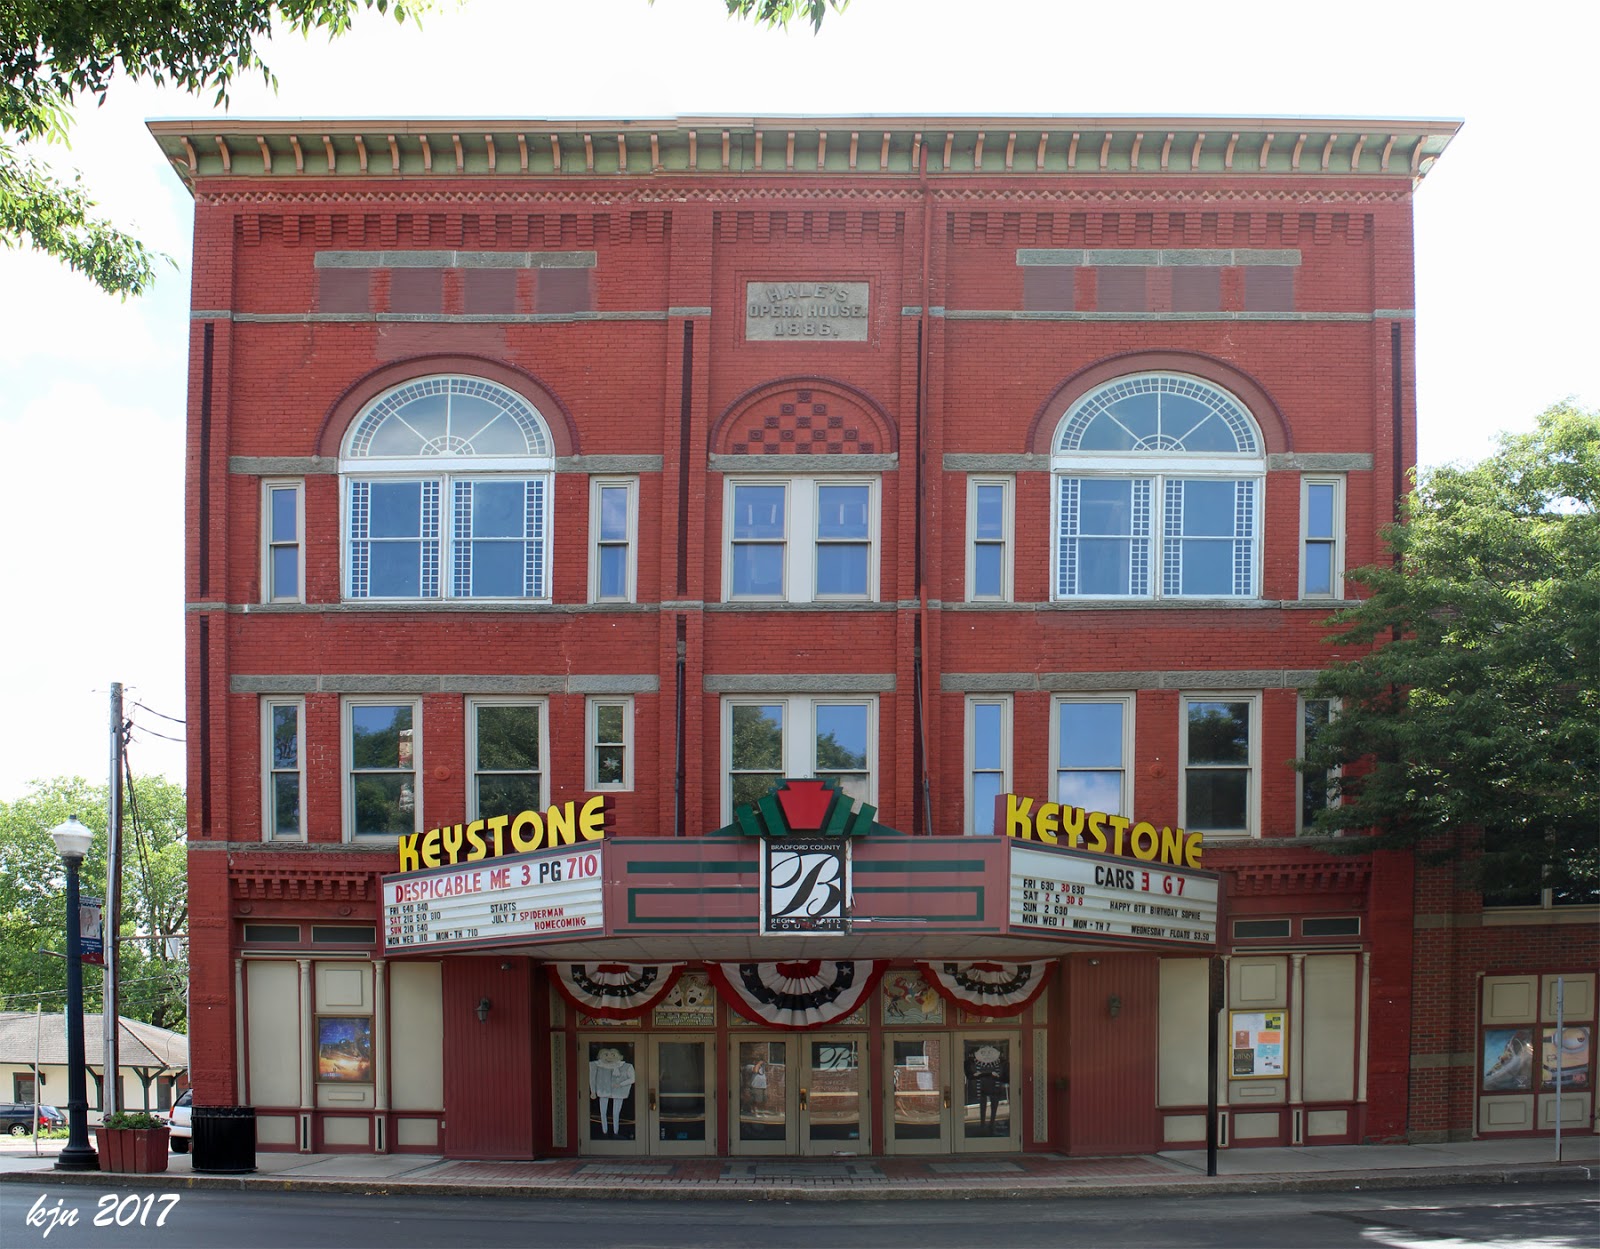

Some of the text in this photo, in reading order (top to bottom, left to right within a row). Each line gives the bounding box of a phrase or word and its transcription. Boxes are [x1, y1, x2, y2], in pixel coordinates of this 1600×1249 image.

[765, 283, 849, 303] HALE'S
[749, 304, 803, 318] OPERA
[398, 795, 604, 873] KEYSTONE
[1006, 793, 1203, 869] KEYSTONE
[395, 854, 598, 903] DESPICABLE ME 3 PG 710
[1095, 866, 1134, 890] CARS
[1024, 879, 1085, 895] FRI 630 3D 830
[1024, 890, 1083, 906] SAT 2 5 3D 8
[390, 907, 399, 915] FRI
[490, 902, 516, 913] STARTS
[1023, 902, 1067, 915] SUN 2 630
[1110, 901, 1200, 920] HAPPY 8TH BIRTHDAY SOPHIE
[390, 916, 401, 925] SAT
[404, 916, 413, 924] 210
[416, 913, 427, 922] 510
[492, 908, 563, 924] JULY 7 SPIDERMAN
[534, 917, 586, 930] HOMECOMING
[1022, 914, 1038, 924] MON
[1043, 916, 1057, 926] WED
[388, 936, 399, 945] MON
[403, 935, 414, 943] WED
[468, 929, 478, 937] 710
[391, 926, 401, 935] SUN
[404, 925, 413, 934] 210
[1131, 925, 1209, 941] WEDNESDAY FLOATS $3.50
